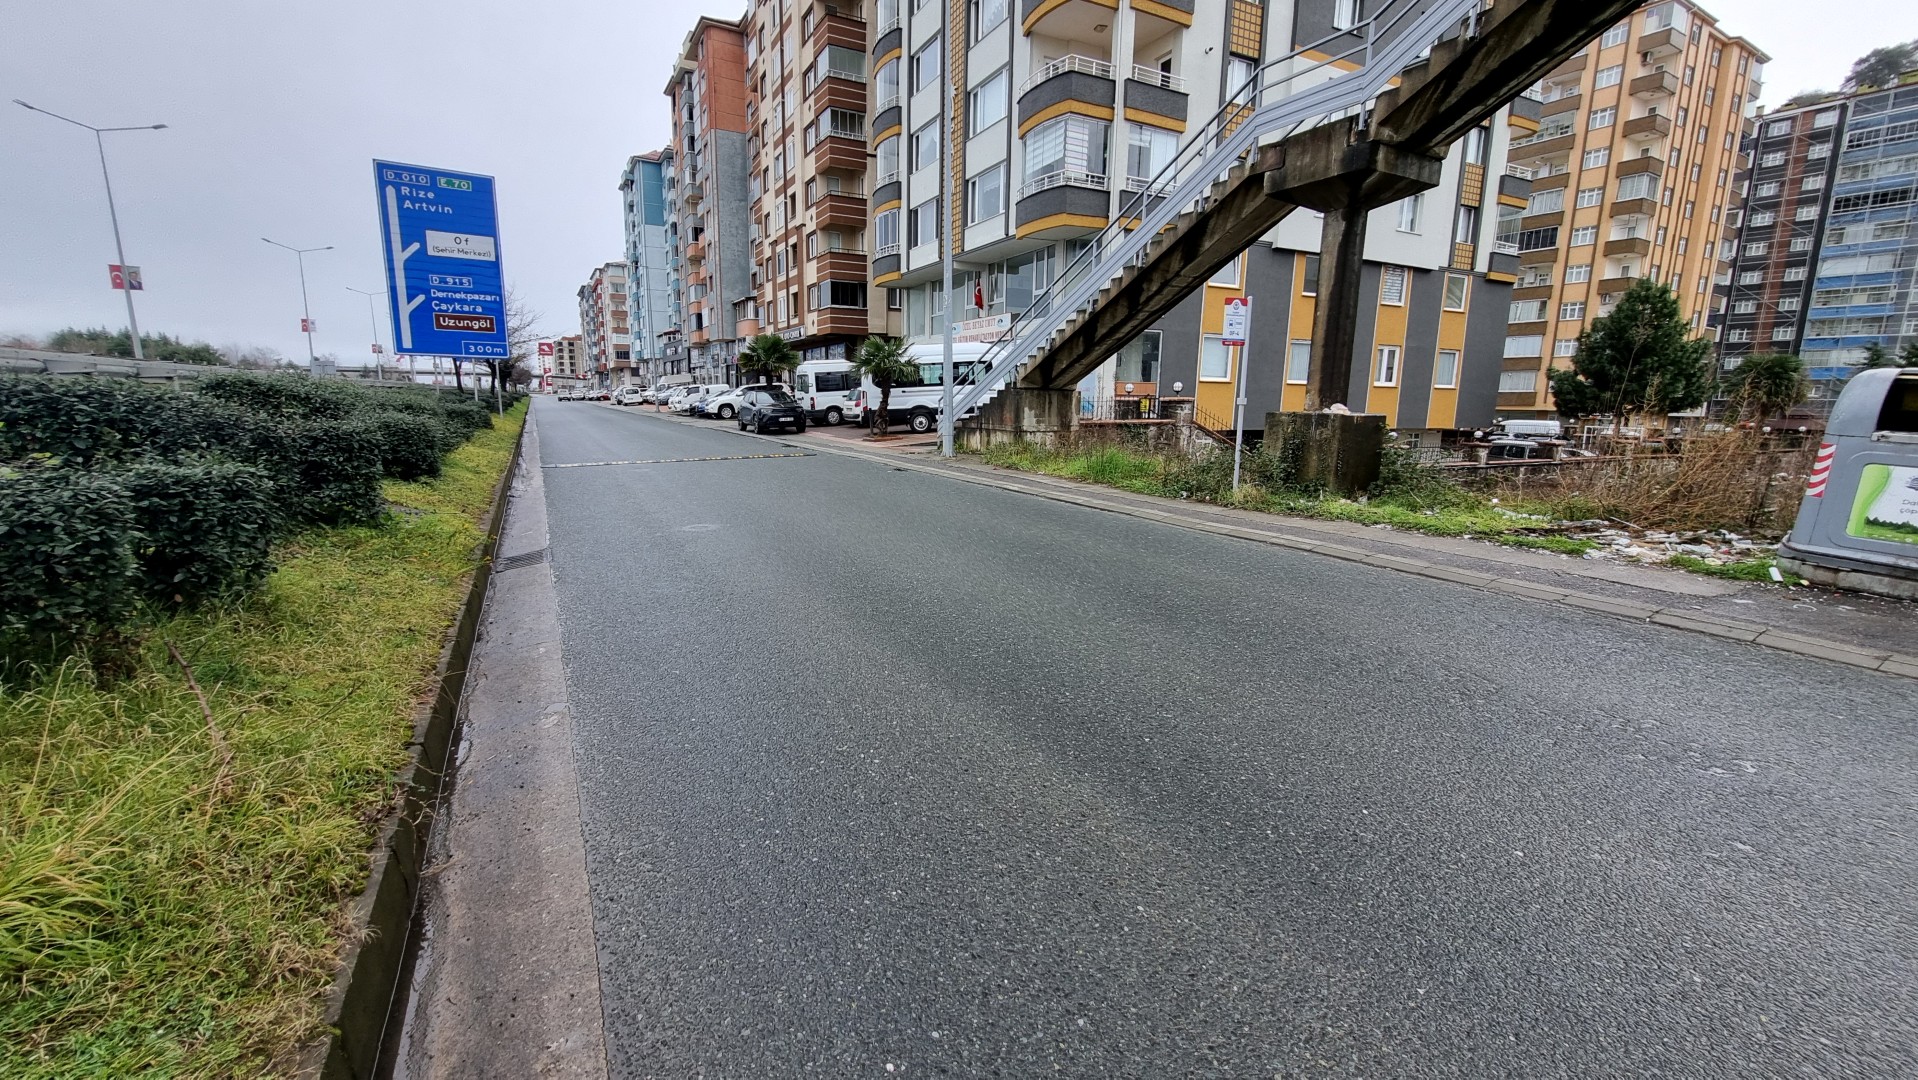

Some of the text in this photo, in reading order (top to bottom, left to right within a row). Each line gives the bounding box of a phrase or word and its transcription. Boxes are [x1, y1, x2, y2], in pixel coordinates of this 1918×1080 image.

[401, 186, 435, 199] Rize
[403, 200, 453, 214] Artvin
[454, 236, 469, 246] Of
[457, 248, 492, 258] Merkezi)
[430, 289, 500, 302] Dernekpazarı
[431, 300, 483, 313] Çaykara
[439, 317, 491, 330] Uzungöl
